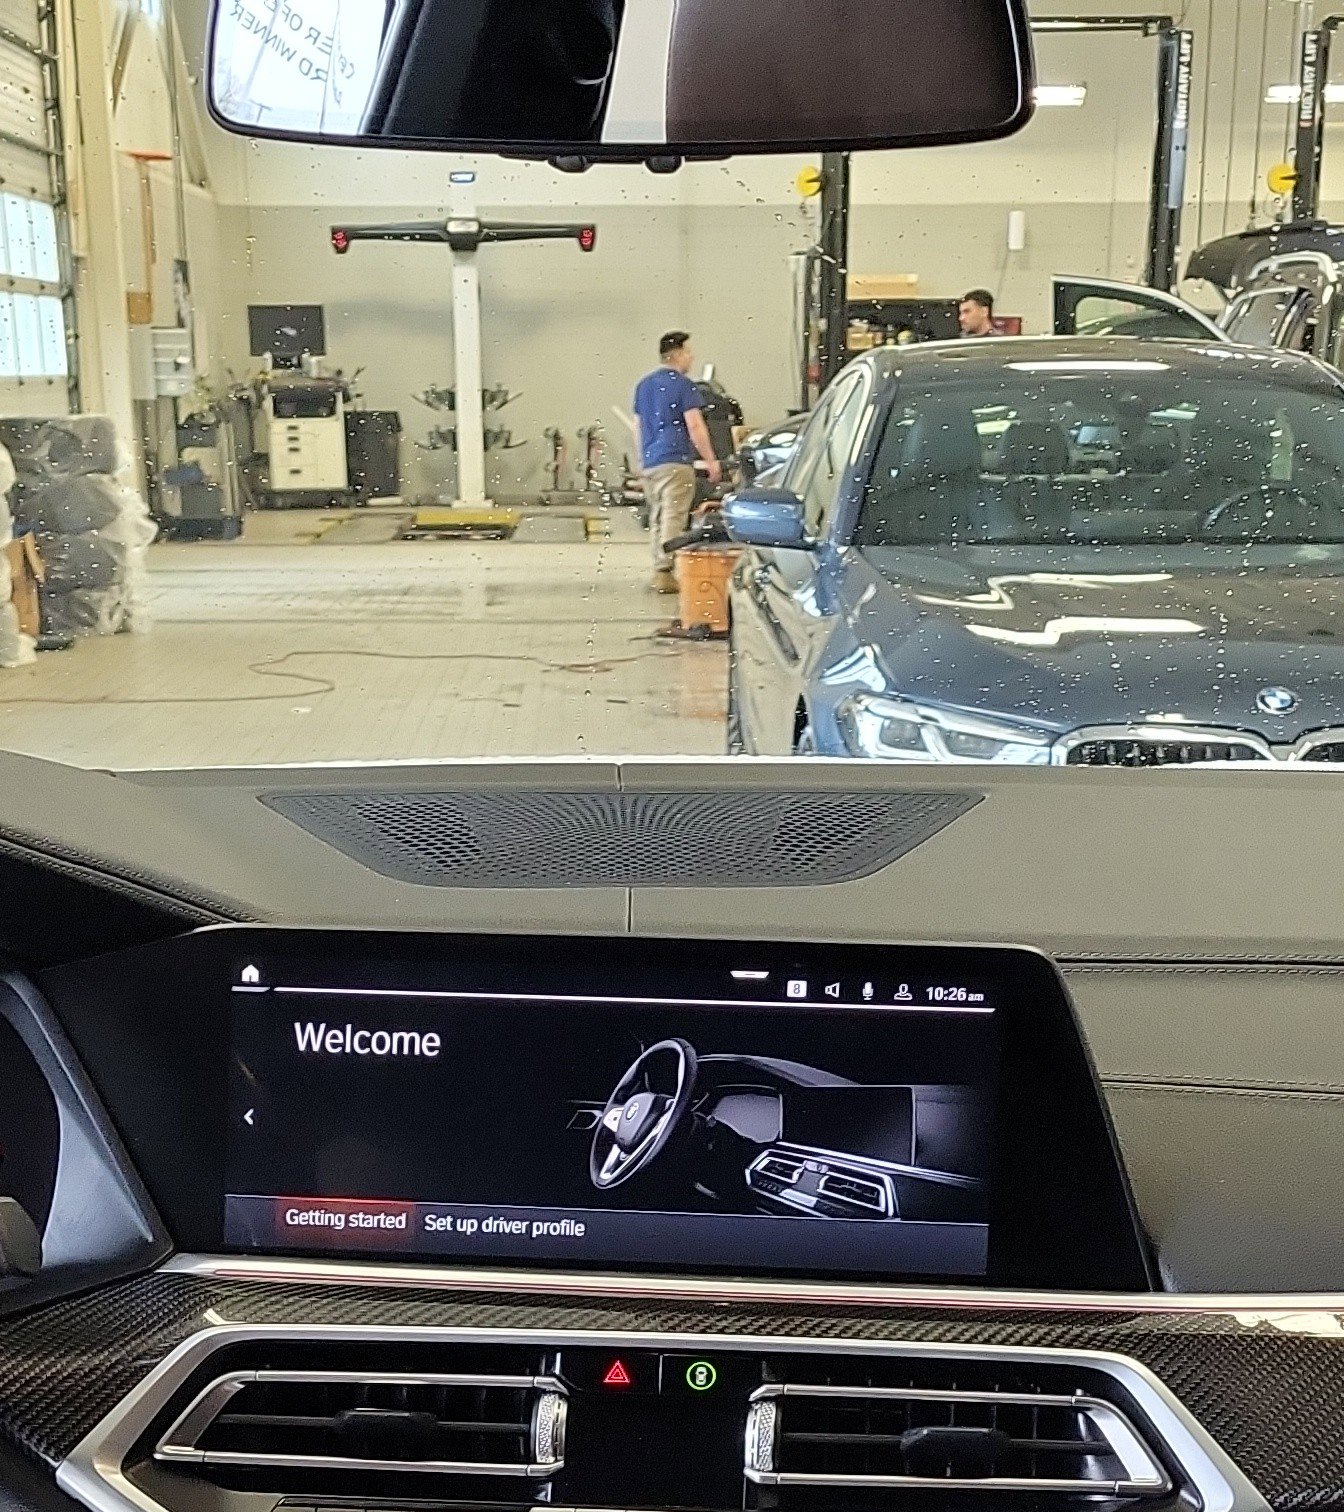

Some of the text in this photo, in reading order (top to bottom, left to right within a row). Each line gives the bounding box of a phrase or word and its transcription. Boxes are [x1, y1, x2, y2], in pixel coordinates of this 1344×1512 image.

[926, 986, 967, 1001] 10:26
[293, 1021, 441, 1057] Welcome
[285, 1208, 586, 1238] Getting started Set up driver profile
